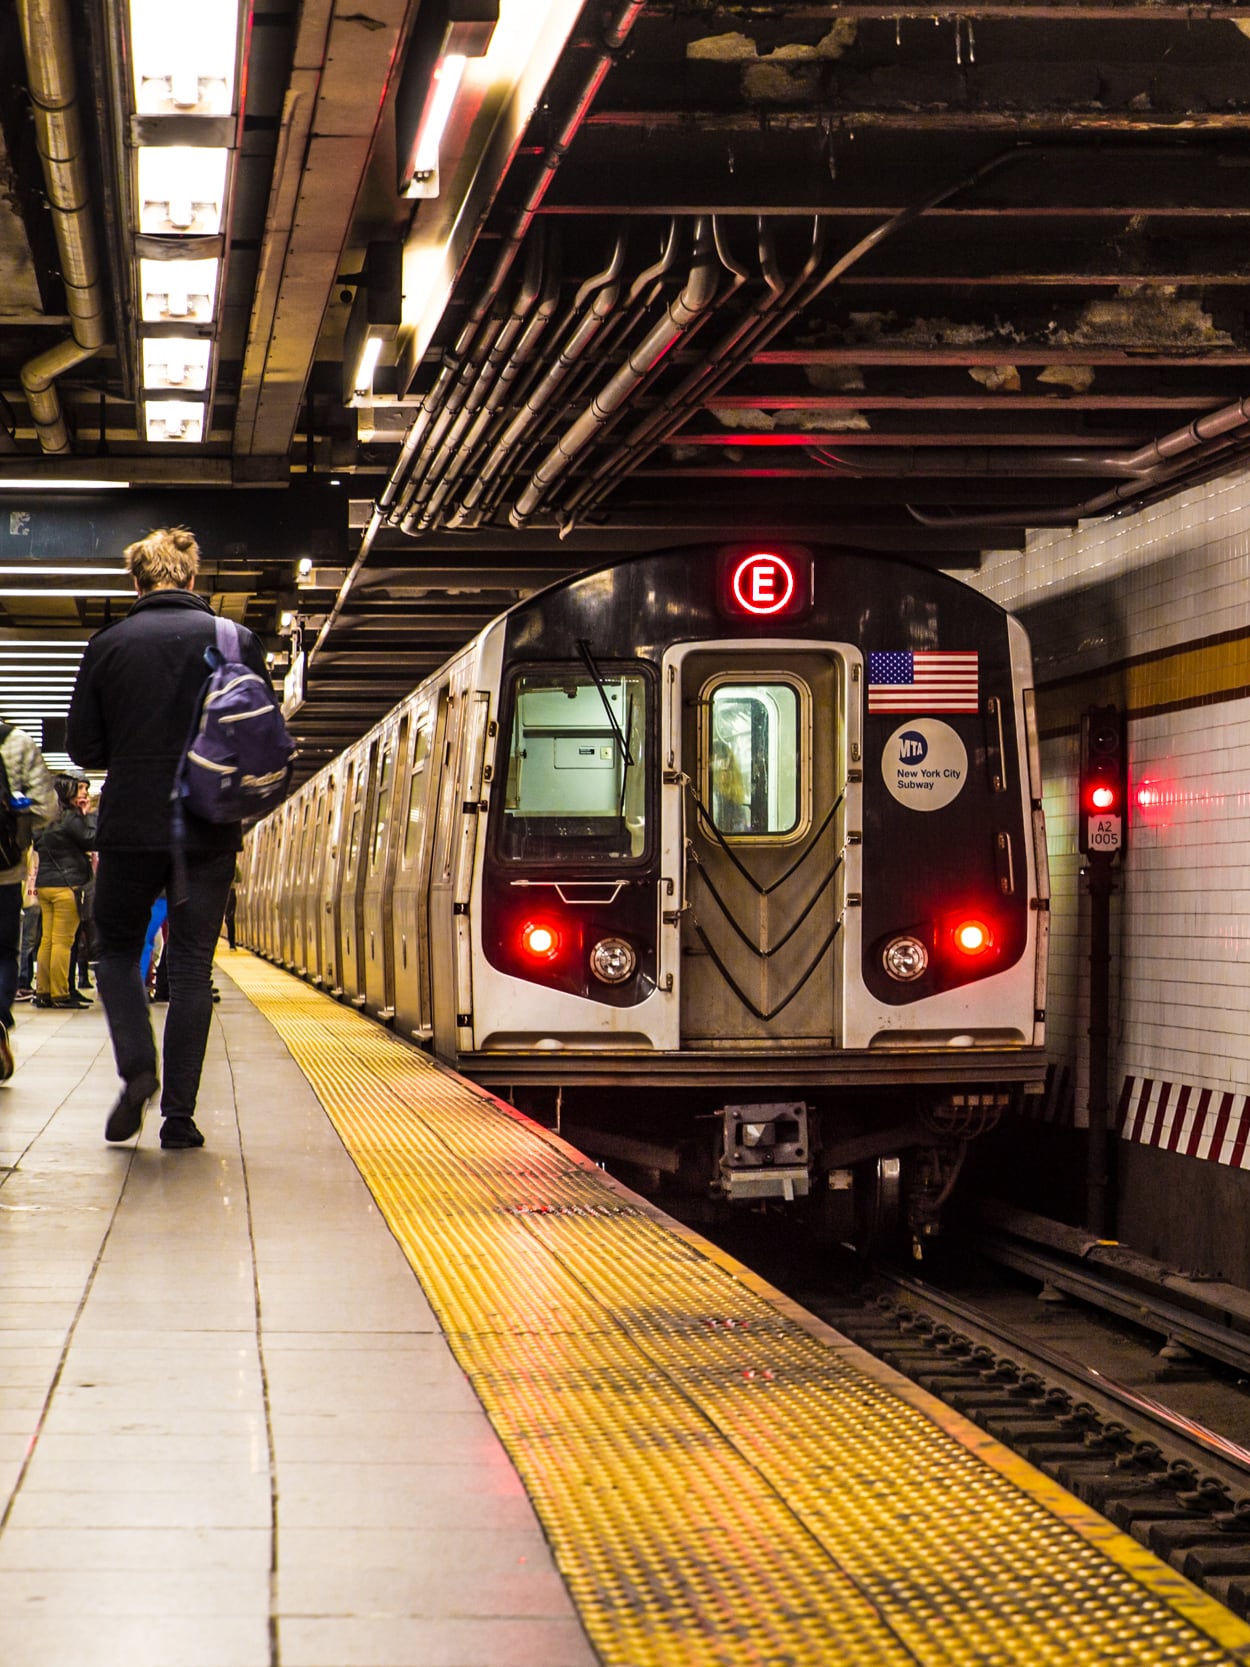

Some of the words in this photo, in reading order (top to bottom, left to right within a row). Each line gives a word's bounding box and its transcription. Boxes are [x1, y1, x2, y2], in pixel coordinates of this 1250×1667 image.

[752, 566, 775, 602] E
[899, 738, 924, 759] MTA
[896, 769, 918, 778] New
[920, 769, 941, 778] York
[943, 769, 961, 780] City
[897, 780, 935, 791] Subway
[1097, 820, 1113, 833] A2
[1091, 833, 1119, 845] 1005
